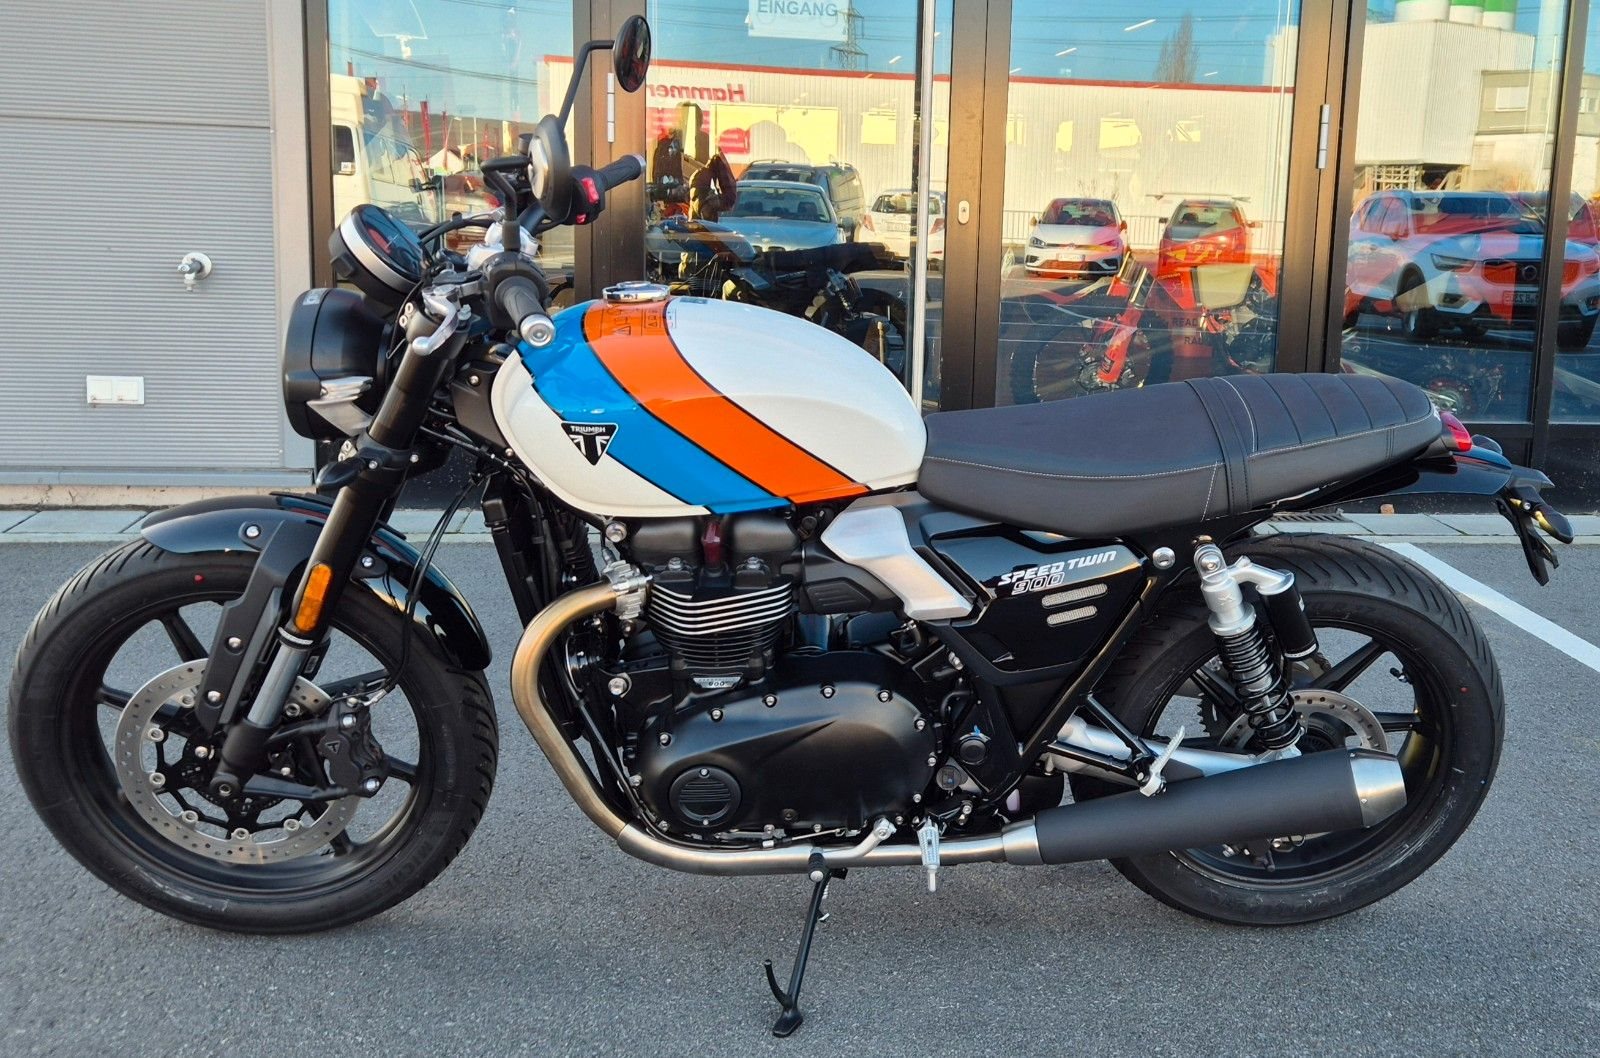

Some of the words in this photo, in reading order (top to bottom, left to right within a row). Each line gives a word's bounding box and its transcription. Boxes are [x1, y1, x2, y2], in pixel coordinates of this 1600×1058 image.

[758, 0, 838, 16] EINGANG
[570, 425, 606, 433] TRIUMPH
[998, 561, 1066, 587] SPEED
[1067, 550, 1118, 571] TWIN
[1011, 571, 1066, 596] 900
